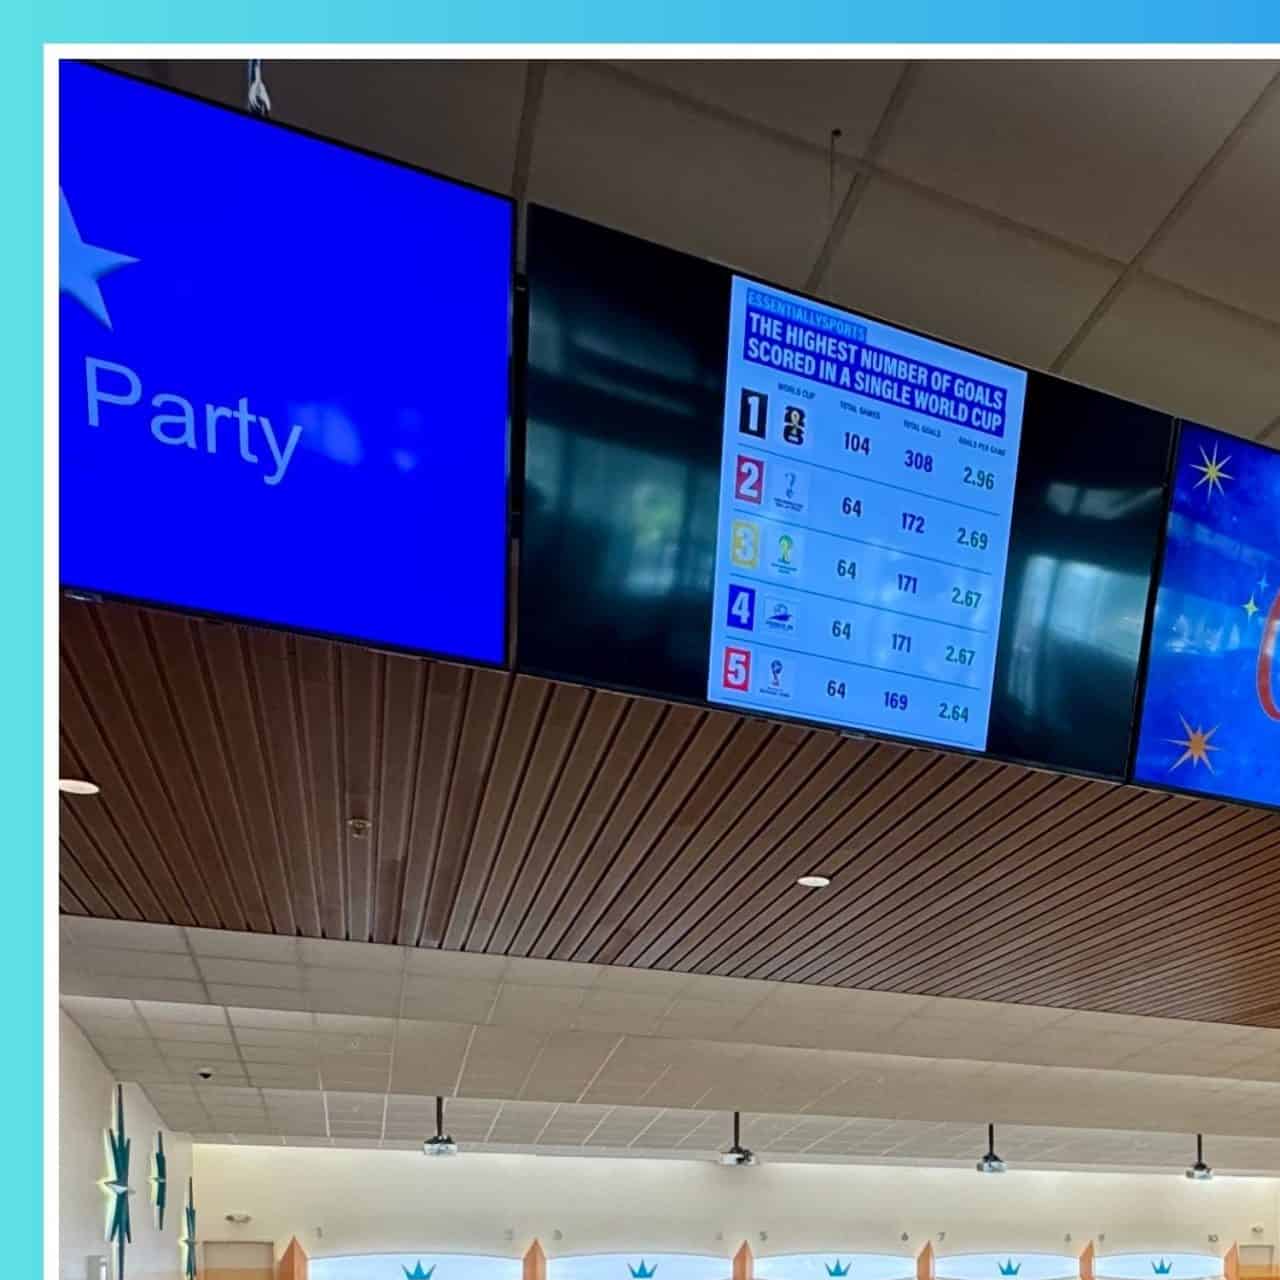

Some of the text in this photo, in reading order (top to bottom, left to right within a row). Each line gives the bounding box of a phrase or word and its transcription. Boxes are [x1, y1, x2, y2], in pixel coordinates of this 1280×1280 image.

[747, 337, 1002, 432] SCORED IN A SINGLE WORLD CUP
[749, 312, 1003, 409] THE HIGHEST NUMBER OF GOALS
[85, 355, 303, 486] Party
[747, 395, 760, 431] 1
[844, 431, 994, 490] 104 308 2.96
[739, 461, 988, 550] 2 64 172 2.69
[735, 526, 982, 608] 3 64 171 2.67
[731, 591, 975, 666] 4 64 171 2.67
[727, 652, 969, 723] 5 64 169 2.64
